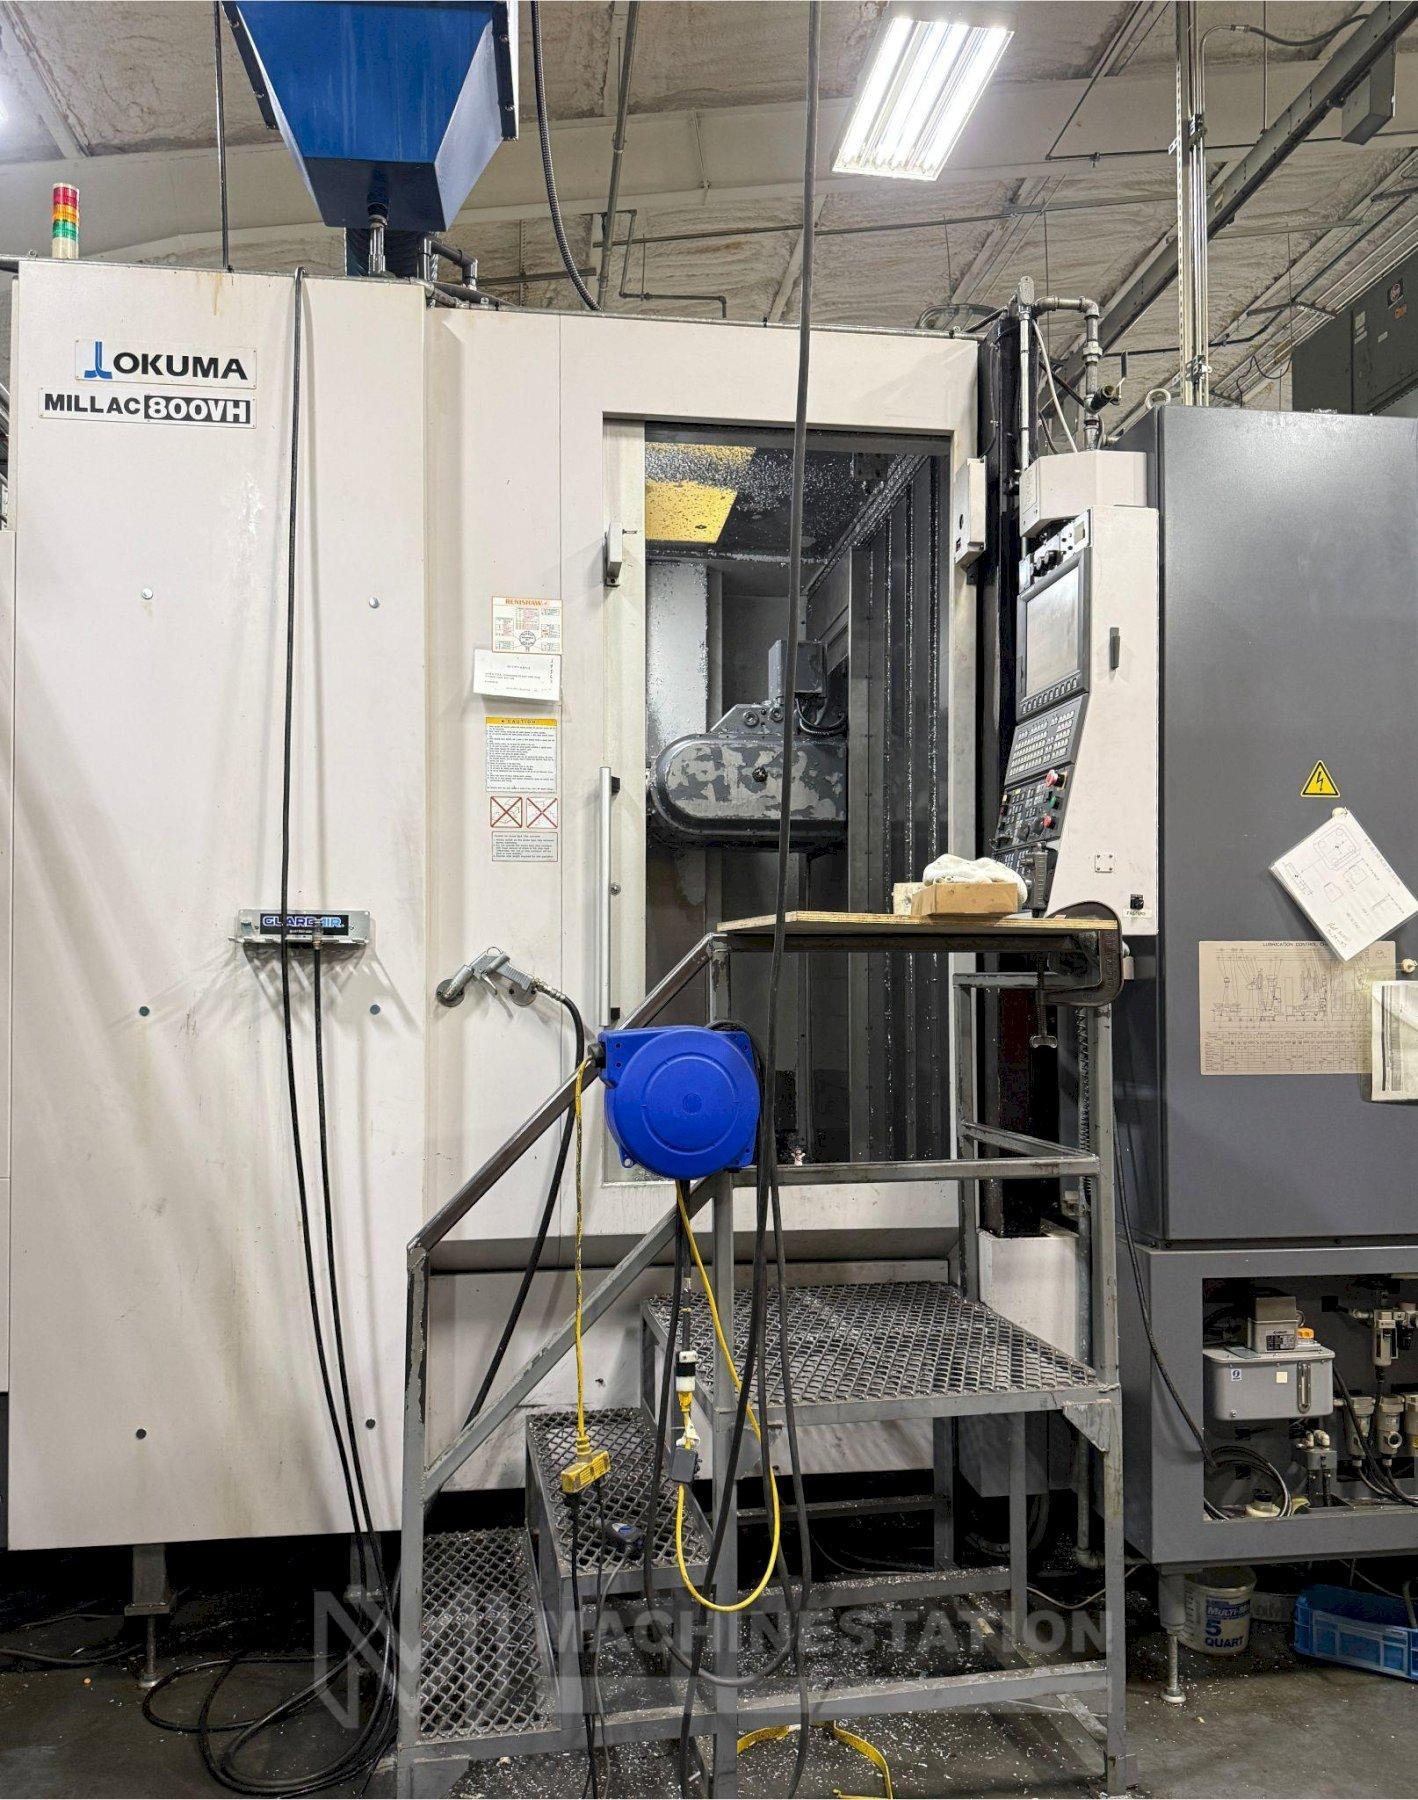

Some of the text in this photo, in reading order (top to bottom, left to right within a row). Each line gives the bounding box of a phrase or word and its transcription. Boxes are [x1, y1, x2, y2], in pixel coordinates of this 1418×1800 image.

[113, 352, 249, 380] OKUMA
[44, 393, 248, 423] MILLAC 800VH
[1205, 1618, 1222, 1636] 5
[1205, 1636, 1243, 1648] QUART
